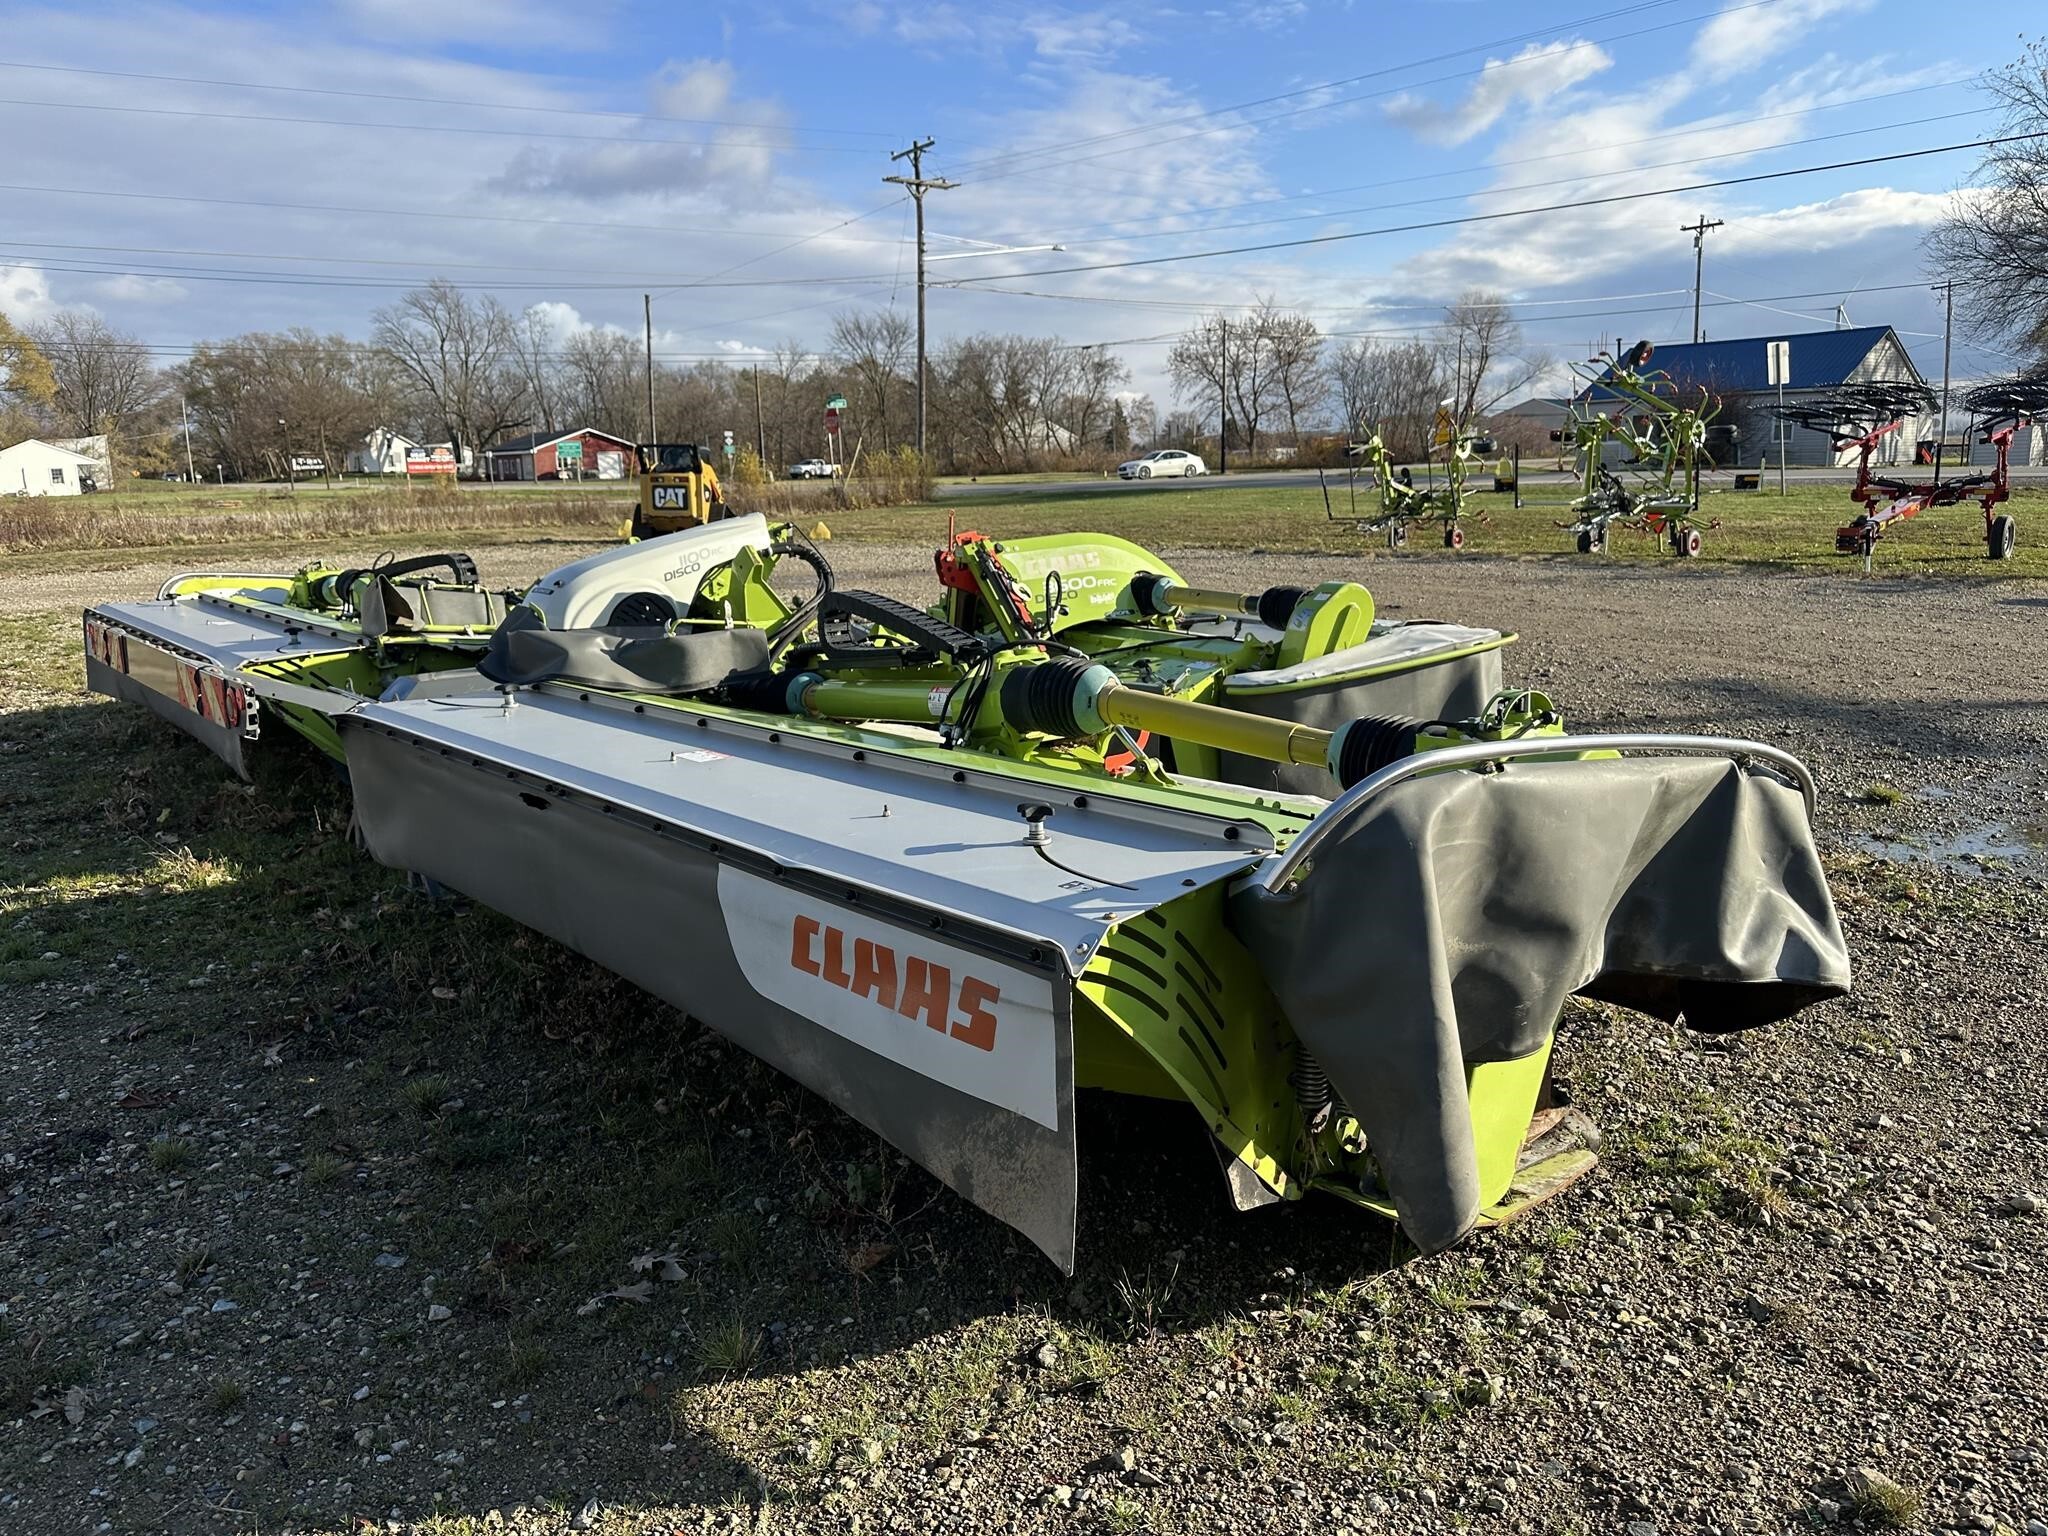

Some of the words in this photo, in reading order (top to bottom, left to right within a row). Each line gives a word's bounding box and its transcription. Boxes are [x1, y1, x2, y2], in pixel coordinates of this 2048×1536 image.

[654, 487, 686, 508] CAT
[664, 562, 701, 582] DISCO
[791, 914, 1000, 1052] CLAAS
